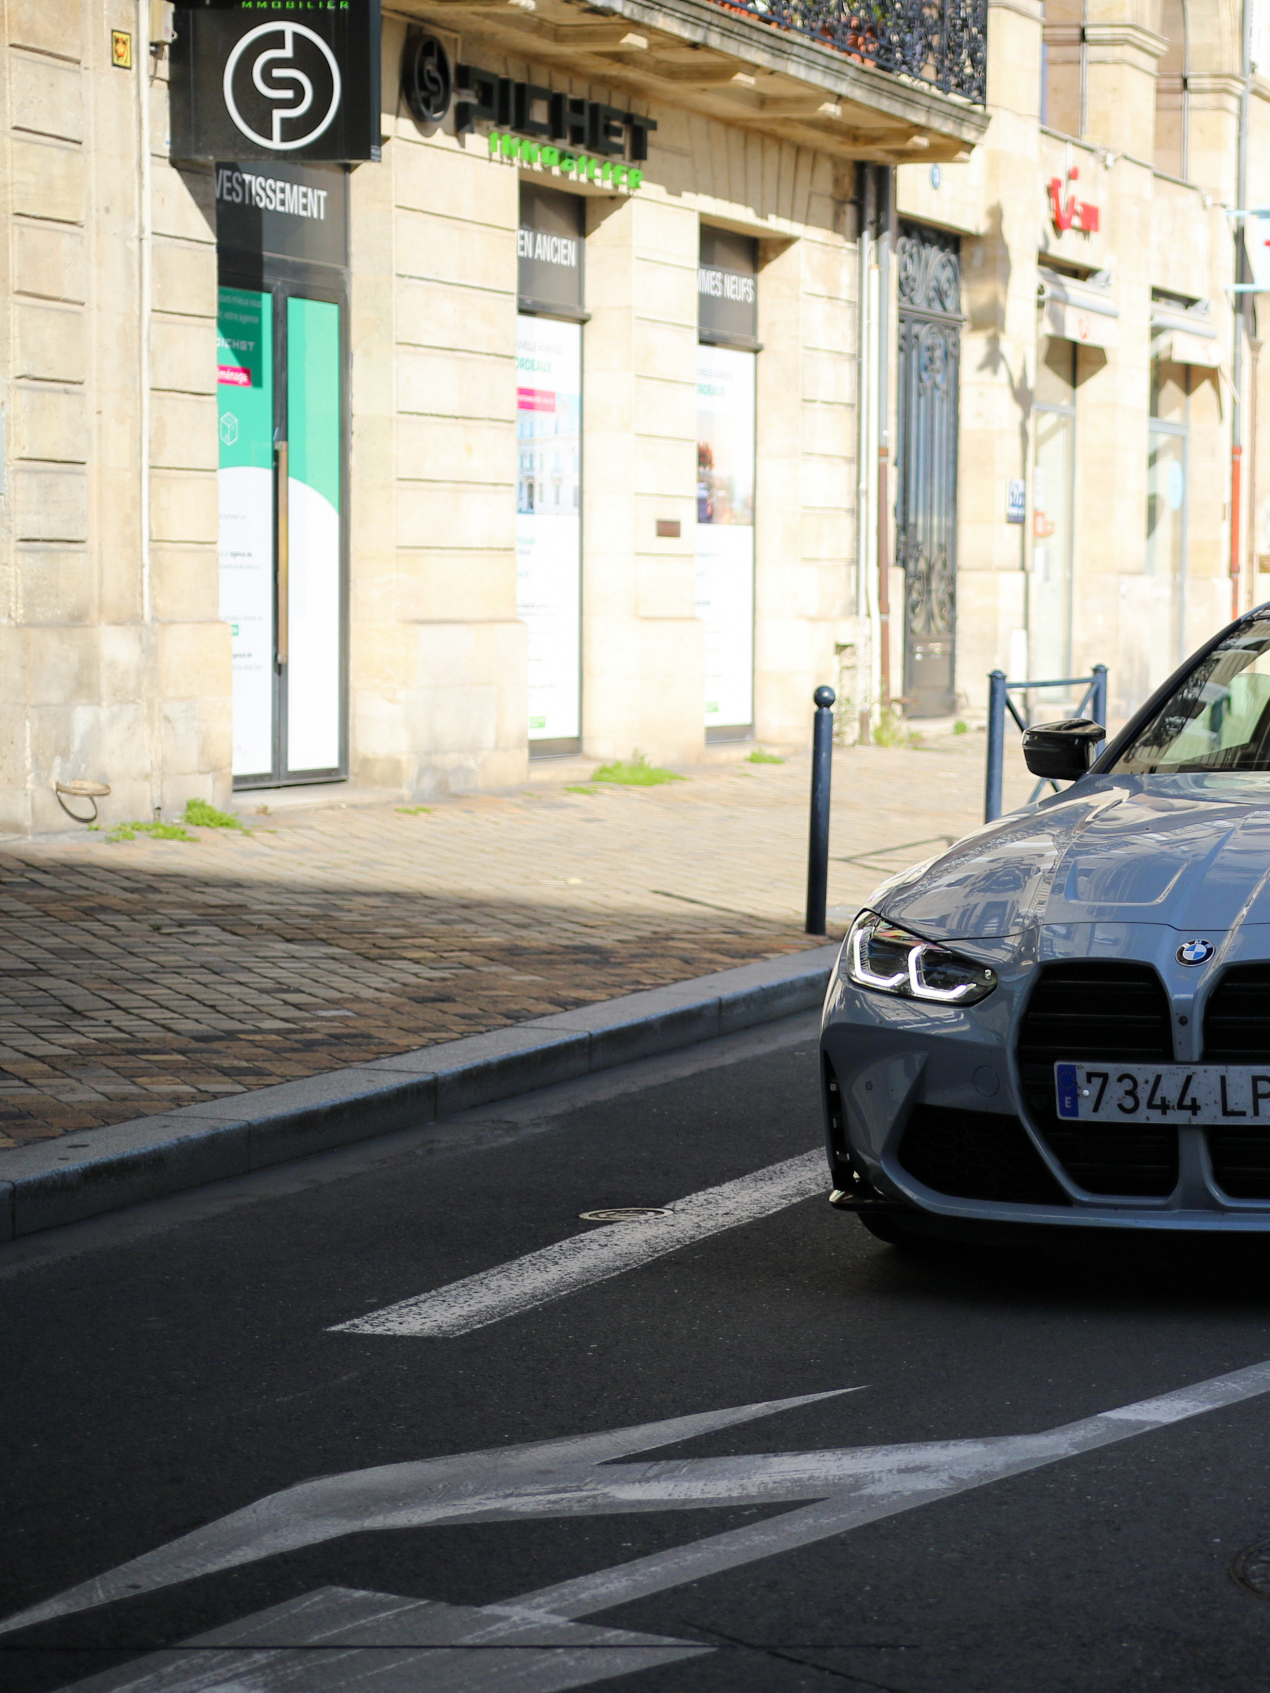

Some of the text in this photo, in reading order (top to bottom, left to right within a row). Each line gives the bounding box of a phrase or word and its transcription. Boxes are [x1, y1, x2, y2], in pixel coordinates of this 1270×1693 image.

[455, 63, 657, 161] PICHET
[489, 131, 643, 189] IMMOBILIER
[517, 228, 577, 268] EN ANCIEN
[723, 273, 755, 304] NEUFS
[1064, 1096, 1072, 1109] E
[1085, 1071, 1201, 1117] 7344
